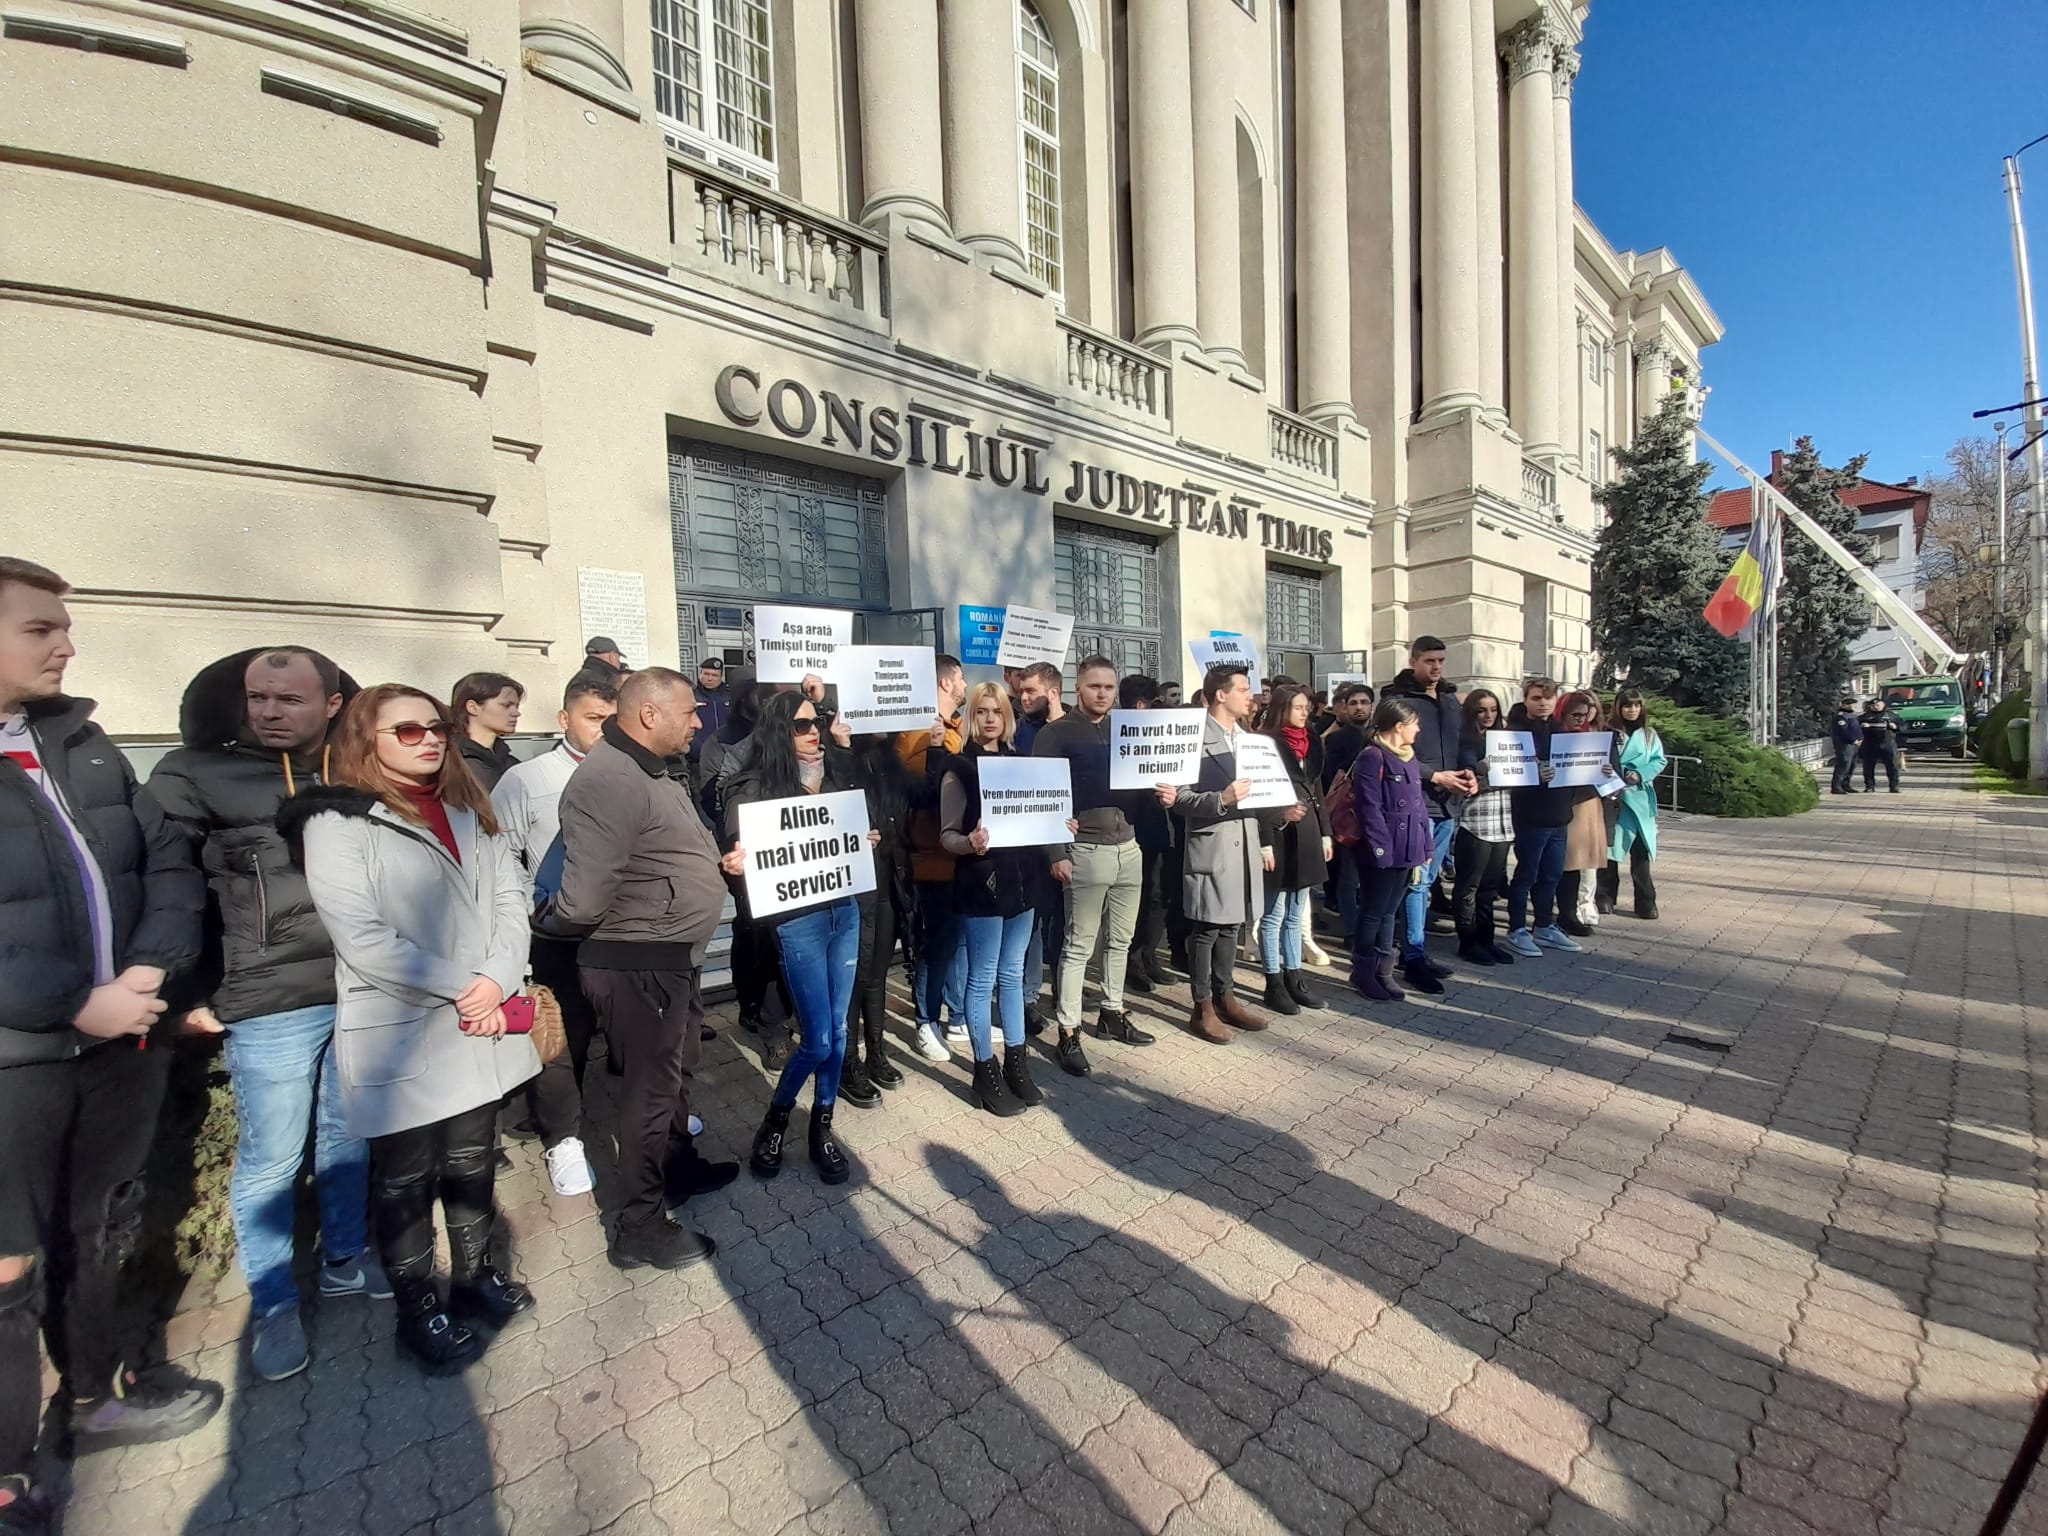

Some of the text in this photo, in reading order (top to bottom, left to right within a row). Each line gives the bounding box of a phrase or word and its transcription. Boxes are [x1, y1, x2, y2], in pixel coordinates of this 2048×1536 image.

[715, 364, 1050, 496] CONSILIUL
[782, 622, 832, 637] Așa arată
[759, 639, 838, 654] Timișul Europ
[1213, 641, 1242, 653] Aline,
[790, 657, 828, 669] cu Nica
[878, 659, 904, 668] Drumul
[874, 671, 909, 682] Timișoara
[877, 695, 909, 705] Giarmata
[844, 709, 873, 719] oglinda
[923, 706, 936, 714] Nica
[1120, 722, 1200, 737] Am vrut 4 benzi
[1119, 743, 1197, 759] și am rămas cu
[1138, 760, 1178, 774] niciuna
[982, 788, 1071, 800] Vrem drumuri europene,
[992, 806, 1001, 814] nu
[1003, 803, 1022, 815] gropi
[1024, 802, 1059, 813] comunale
[780, 805, 834, 830] Aline,
[755, 832, 860, 870] mai vino la
